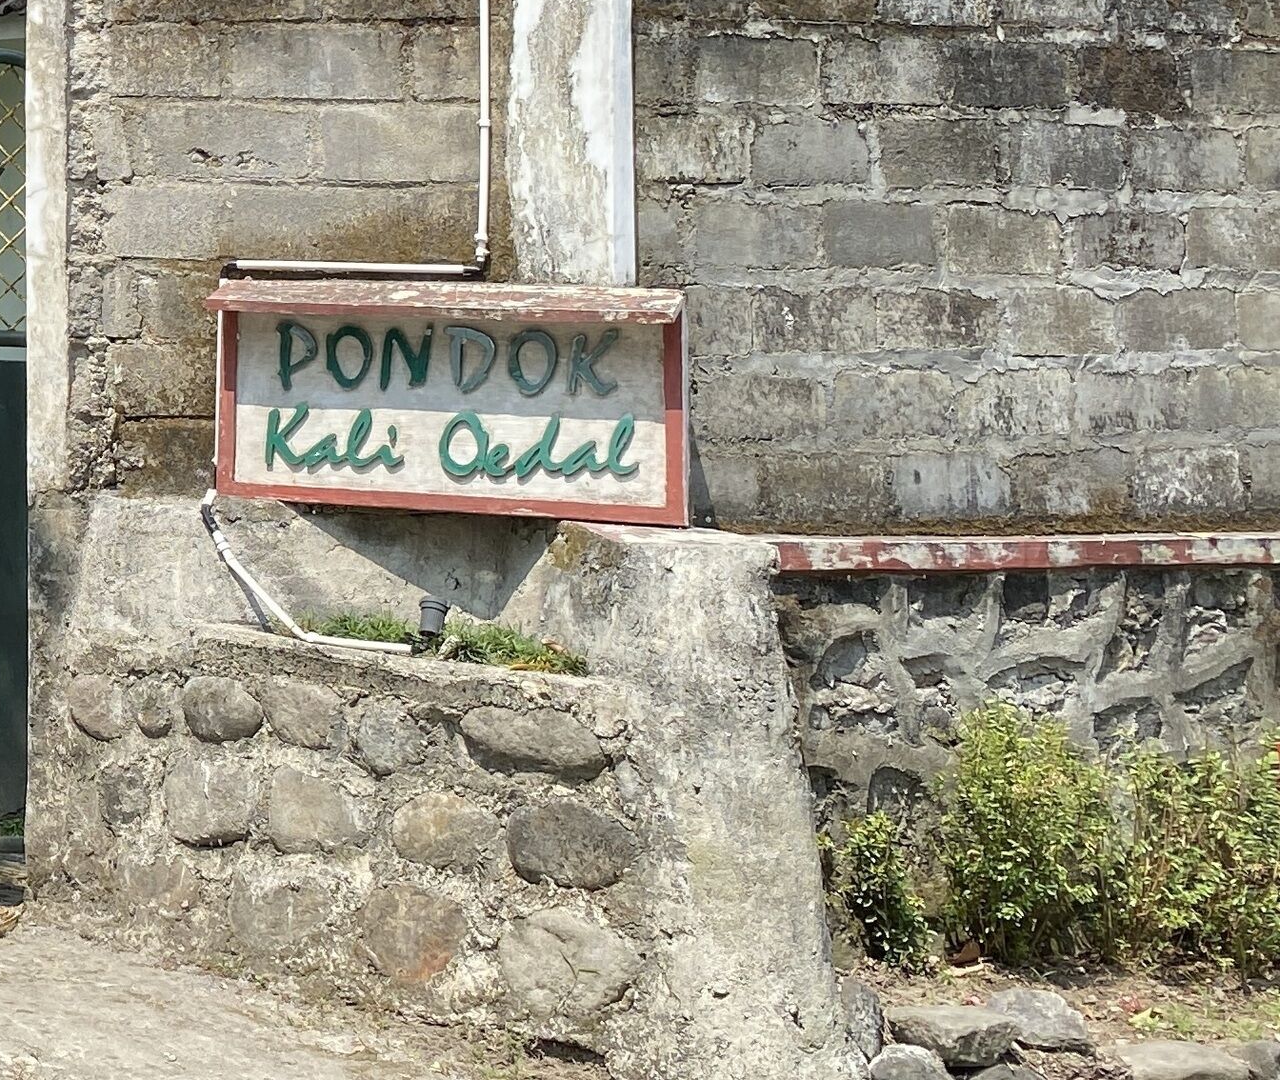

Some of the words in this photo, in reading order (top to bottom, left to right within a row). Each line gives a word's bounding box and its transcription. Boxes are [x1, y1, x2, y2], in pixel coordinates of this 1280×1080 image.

[276, 322, 620, 397] PONDOK
[265, 402, 405, 470] Kali
[439, 411, 641, 478] Oedal
